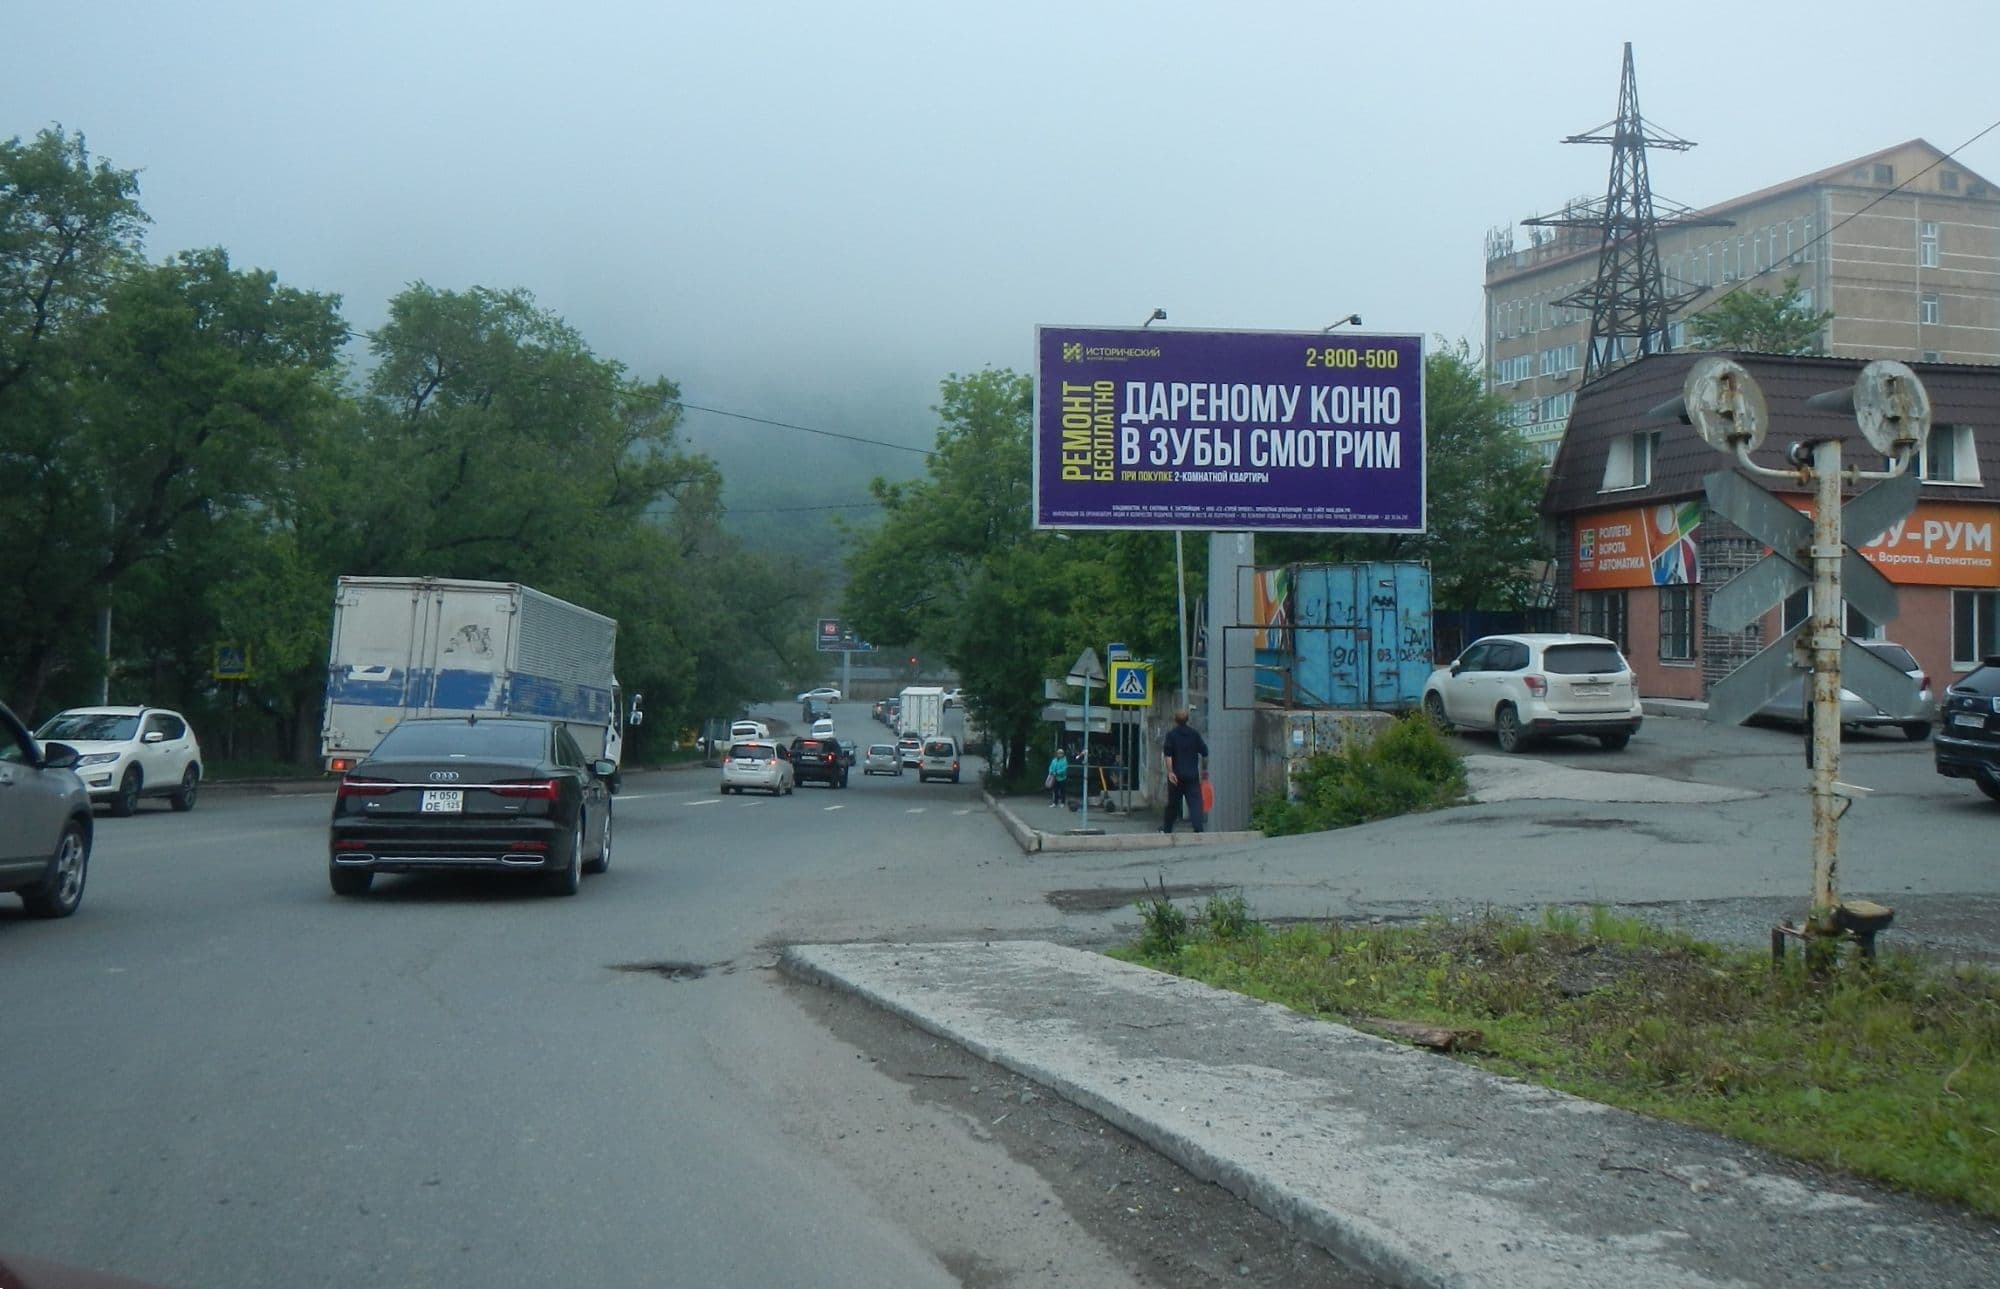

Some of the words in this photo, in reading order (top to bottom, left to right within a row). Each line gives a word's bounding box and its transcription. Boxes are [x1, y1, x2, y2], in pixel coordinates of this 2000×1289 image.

[1086, 346, 1160, 357] ИСТОРИЧЕСКИЙ
[1306, 348, 1398, 368] 2-800-500
[1121, 381, 1301, 424] ДАРЕНОМУ
[1310, 386, 1400, 424] КОНЮ
[1062, 381, 1091, 480] РЕМОНТ
[1094, 380, 1114, 480] БЕСПЛАТНО
[1121, 427, 1140, 465] В
[1150, 427, 1240, 467] ЗУБЫ
[1250, 429, 1400, 468] СМОТРИМ
[1121, 471, 1136, 481] ПРИ
[1138, 471, 1173, 482] ПОКУПКЕ
[1174, 471, 1228, 482] 2-КОМНАТНОЙ
[1229, 472, 1269, 483] КВАРТИРЫ
[1599, 524, 1632, 538] РОЛЛЕТЫ
[1866, 519, 1992, 552] У-РУМ
[1599, 541, 1626, 555] ВОРОТА
[1599, 556, 1645, 571] АВТОМАТИКА
[1926, 554, 1992, 567] Автоматика
[440, 792, 458, 800] 050
[425, 803, 441, 811] ОЕ
